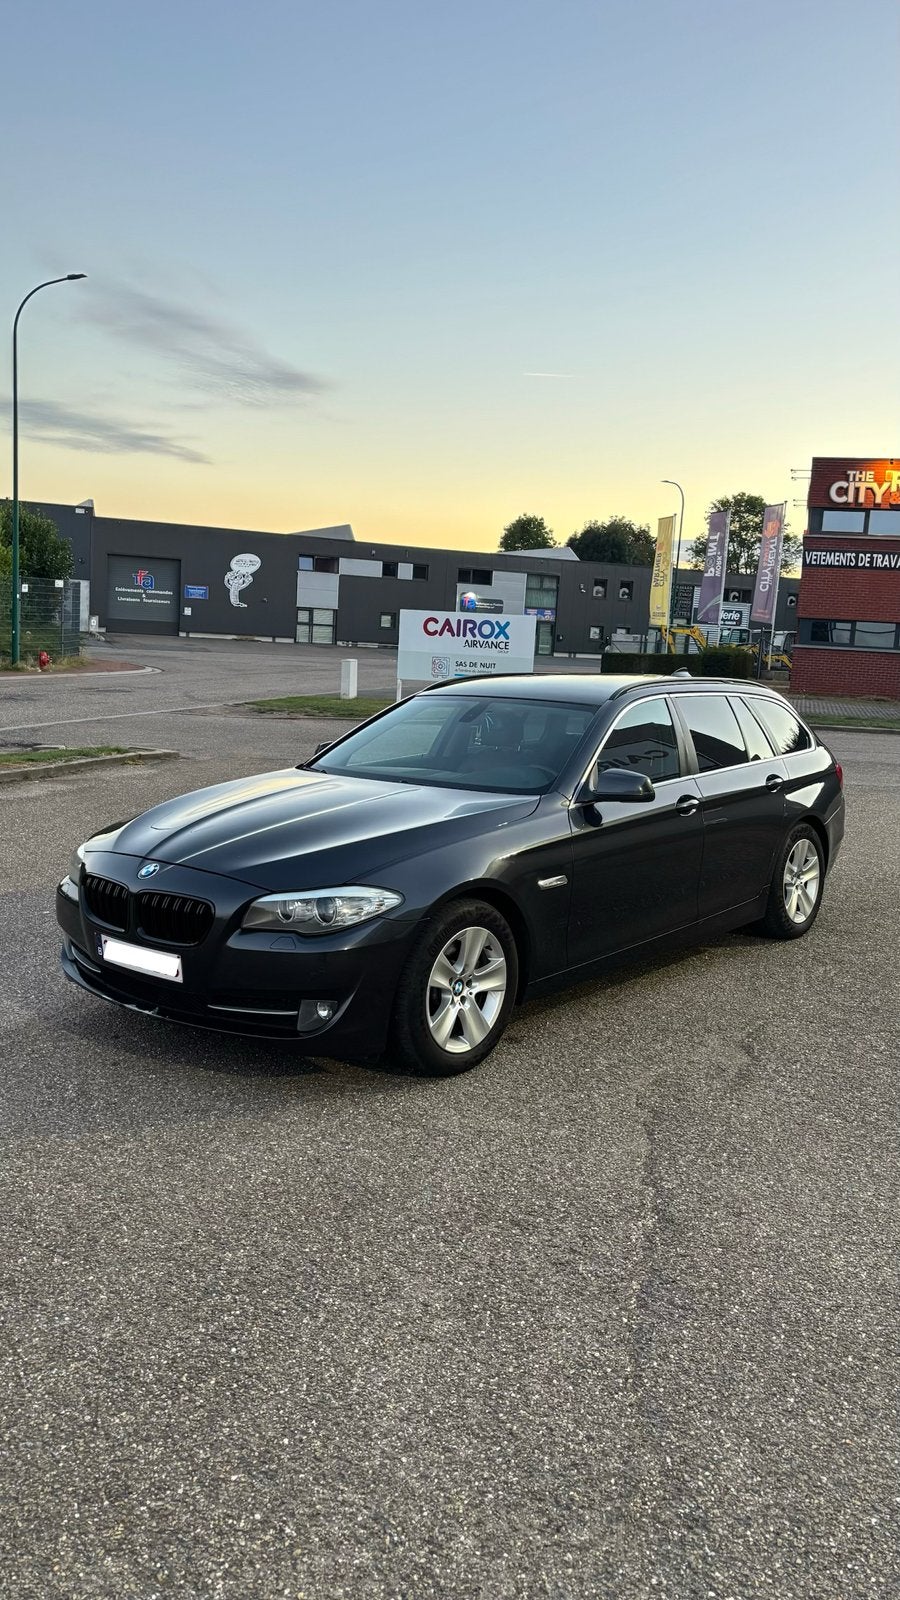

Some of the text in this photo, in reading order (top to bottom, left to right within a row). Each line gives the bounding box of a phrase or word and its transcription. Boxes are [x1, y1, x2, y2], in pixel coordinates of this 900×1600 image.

[847, 471, 875, 482] THE
[829, 480, 891, 504] CITY
[805, 551, 856, 566] VETEMENTS
[858, 553, 870, 567] DE
[423, 617, 511, 640] CAIROX
[463, 639, 510, 650] AIRVANCE
[455, 660, 467, 668] SAS
